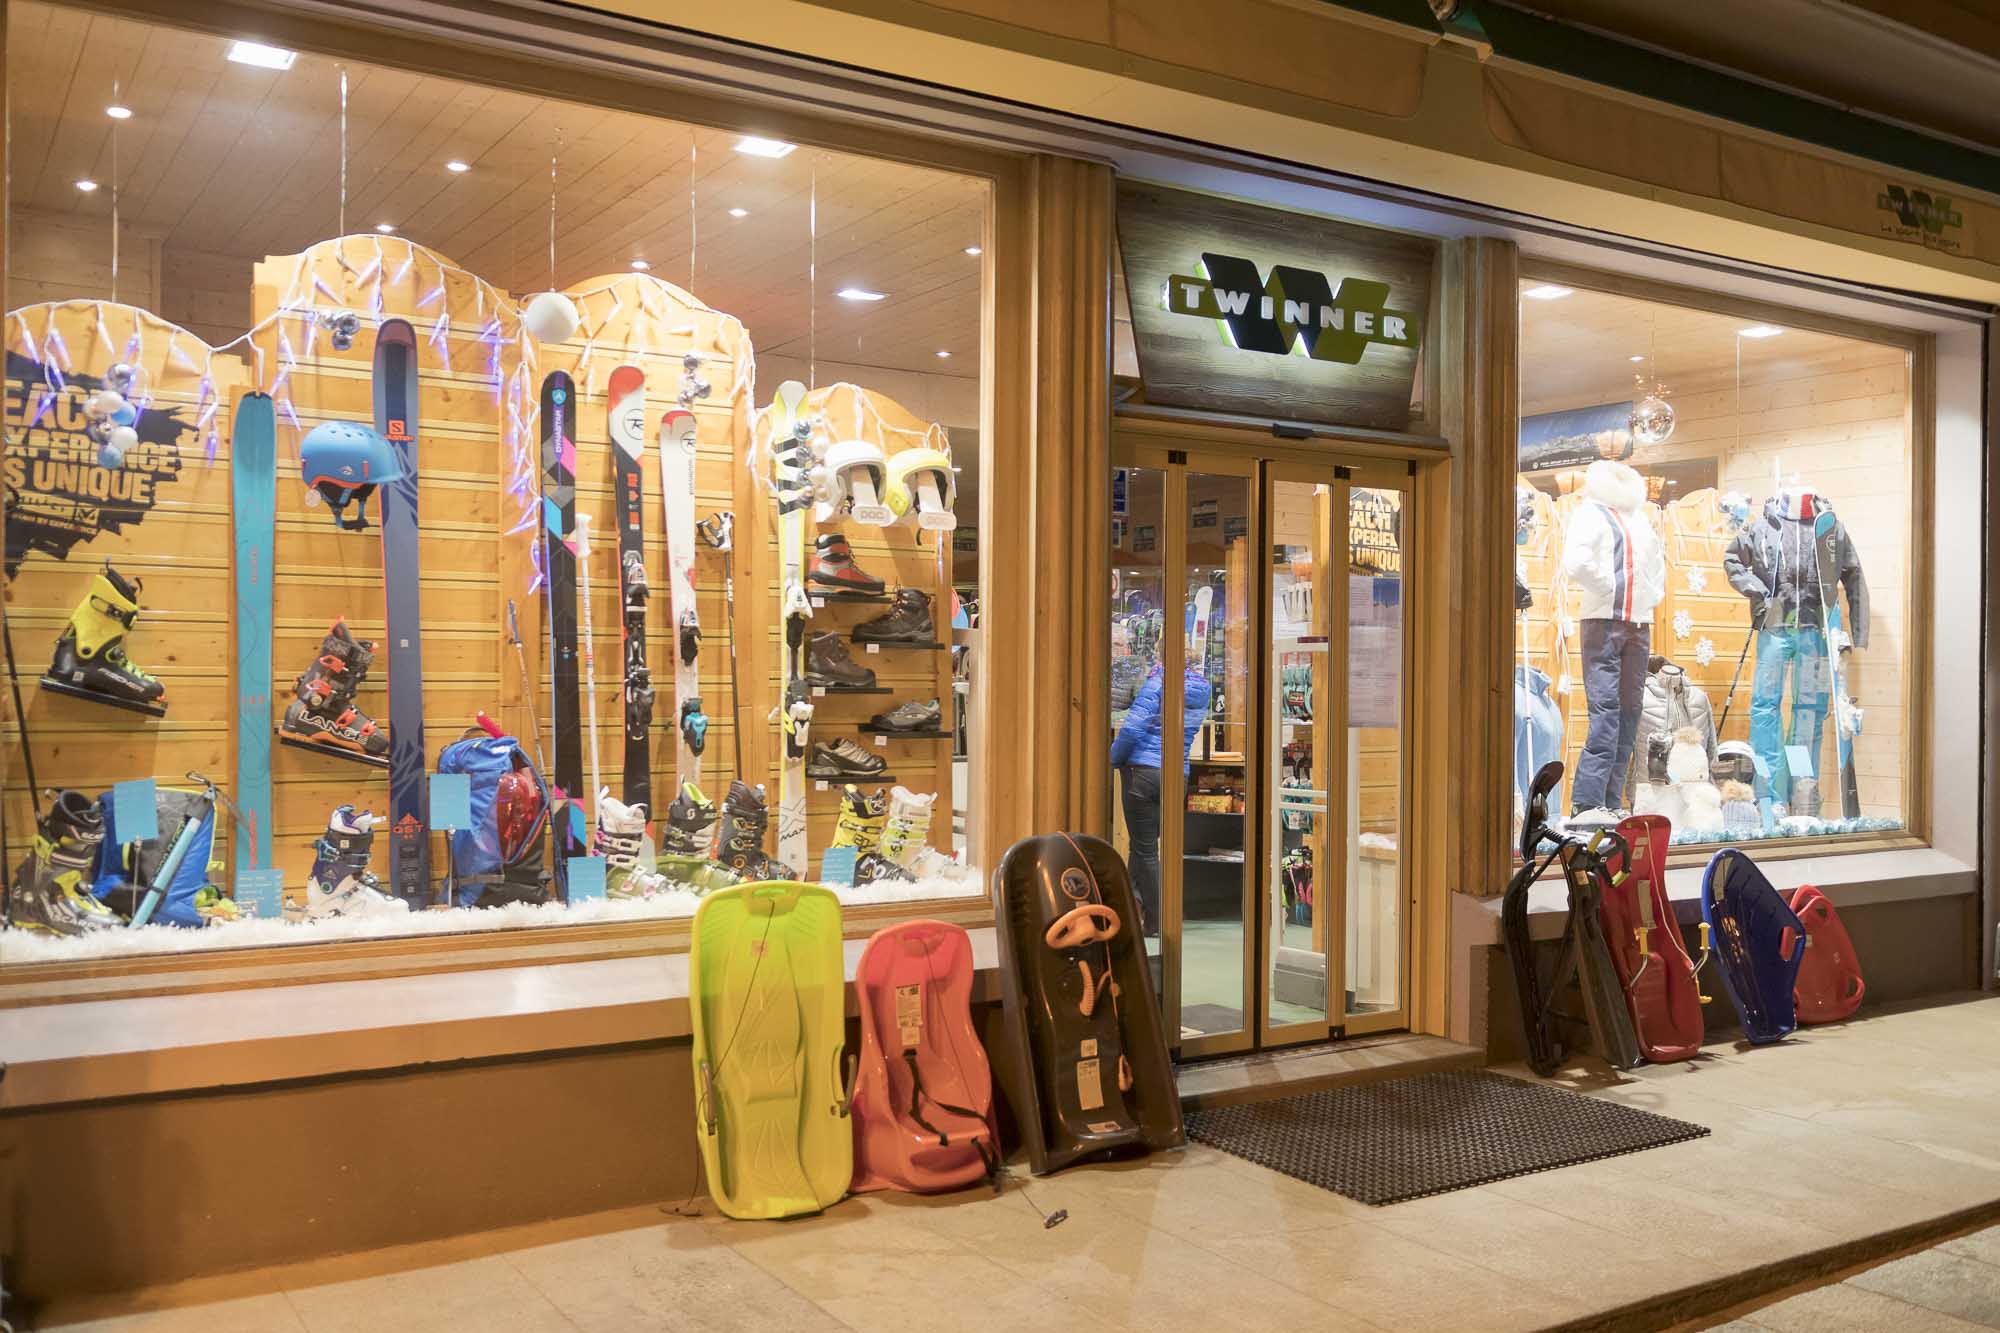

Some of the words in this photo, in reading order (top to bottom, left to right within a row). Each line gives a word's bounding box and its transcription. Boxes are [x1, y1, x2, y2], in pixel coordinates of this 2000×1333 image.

[1181, 282, 1407, 340] TWINNER
[4, 379, 98, 431] EAC
[33, 460, 154, 504] UNIQUE
